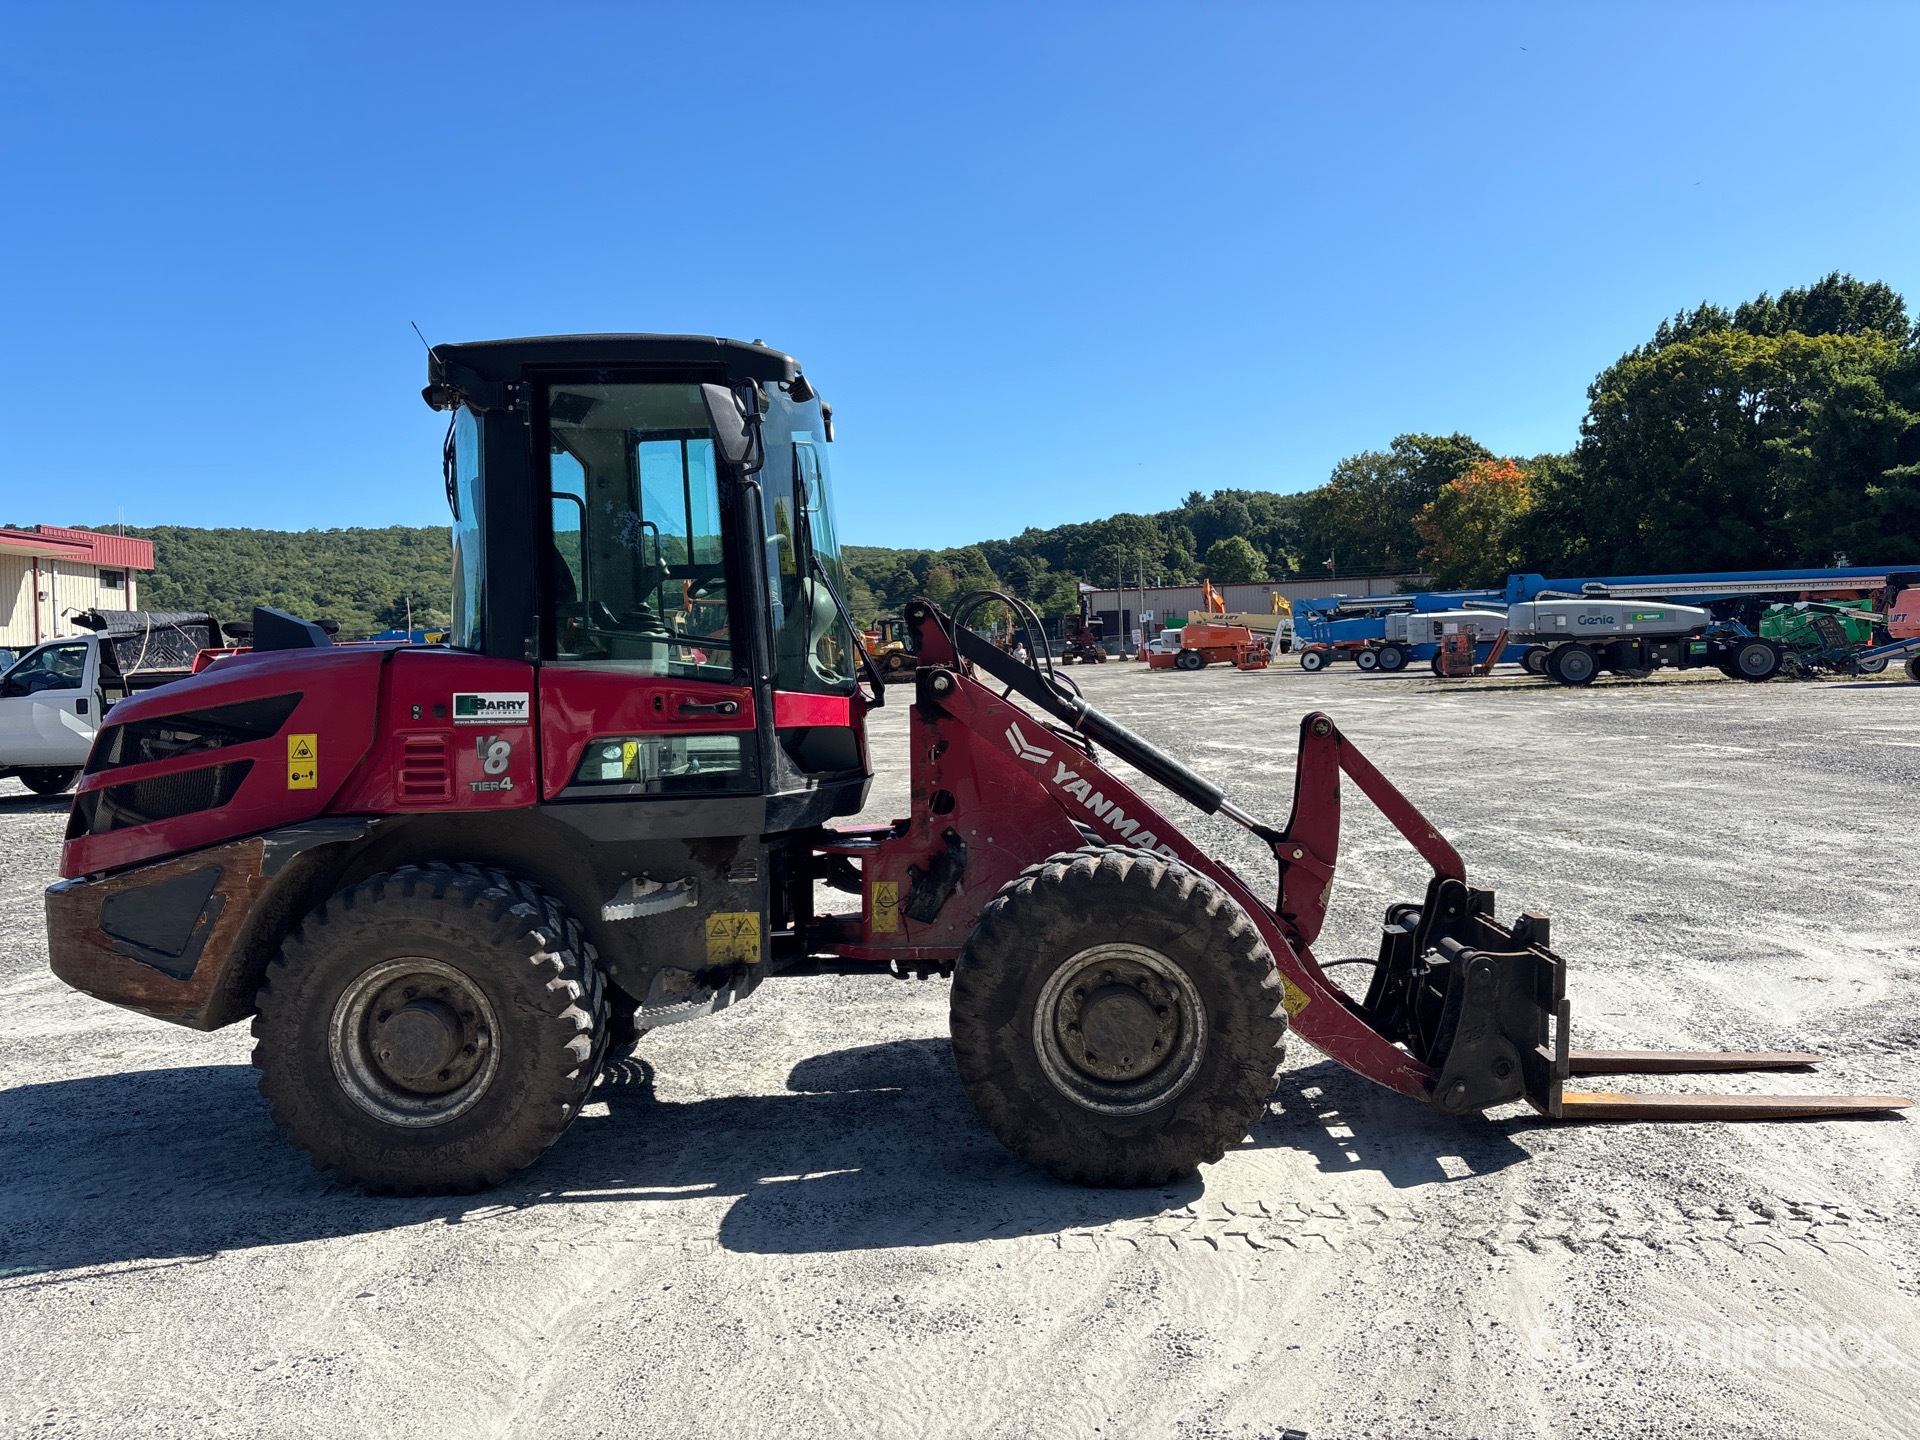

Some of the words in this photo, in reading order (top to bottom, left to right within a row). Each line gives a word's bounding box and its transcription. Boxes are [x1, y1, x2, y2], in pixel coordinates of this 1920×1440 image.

[1577, 614, 1614, 626] Genie
[471, 697, 526, 710] BARRY
[475, 735, 512, 775] V8
